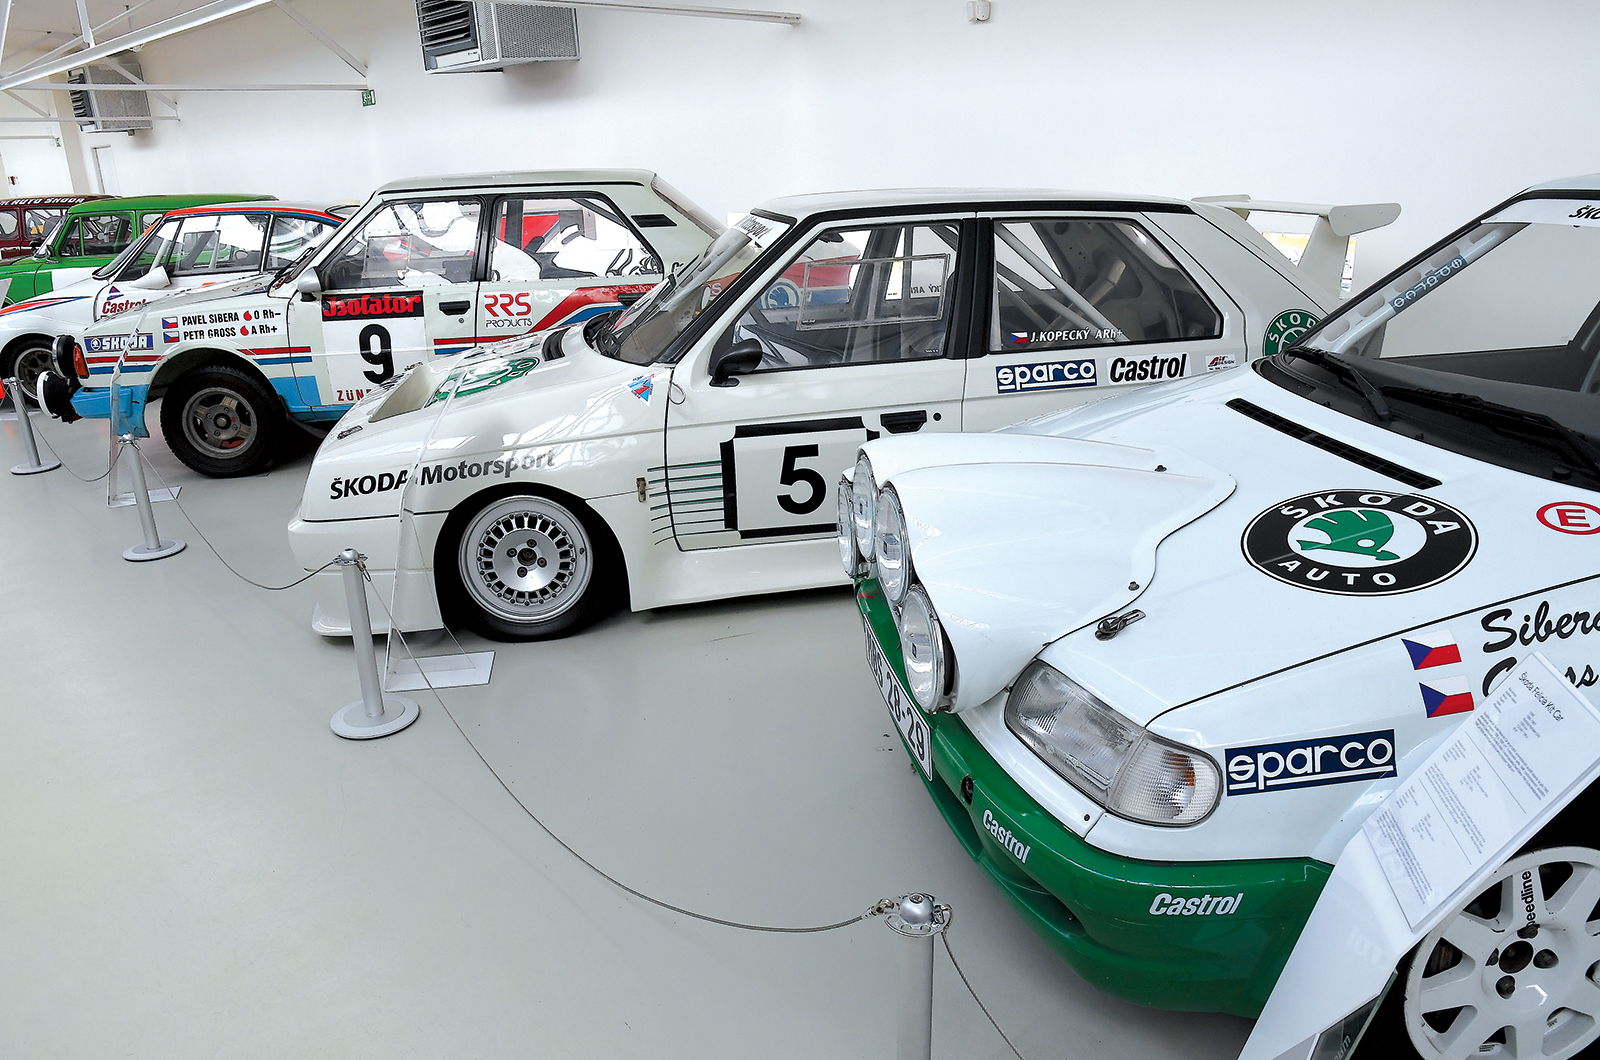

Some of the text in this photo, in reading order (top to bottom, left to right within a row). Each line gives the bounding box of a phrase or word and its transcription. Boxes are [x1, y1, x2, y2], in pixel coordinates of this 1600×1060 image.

[1394, 258, 1463, 307] sparco
[102, 299, 147, 314] Castr
[182, 315, 208, 326] PAVEL
[209, 312, 240, 324] SIBERA
[484, 292, 532, 317] RRS
[183, 324, 278, 341] PETR GROSS A Rh+
[485, 318, 533, 328] PRODUCTS
[1030, 326, 1091, 343] J.KOPECKÝ
[1267, 313, 1317, 343] ŠKOD
[359, 323, 395, 385] 9
[1110, 353, 1187, 383] Castrol
[997, 360, 1095, 391] sparco
[330, 450, 555, 500] ŠKODA Motorsport
[776, 443, 827, 515] 5
[1278, 492, 1461, 536] ŠKODA
[1556, 508, 1591, 528] E
[1278, 559, 1398, 587] AUTO
[1518, 671, 1535, 691] Škoda
[1544, 701, 1556, 714] Kit
[1552, 709, 1564, 722] Car
[886, 671, 925, 762] 28-29
[1228, 738, 1394, 791] sparco
[982, 808, 1031, 864] Castrol
[1149, 892, 1245, 916] Castrol
